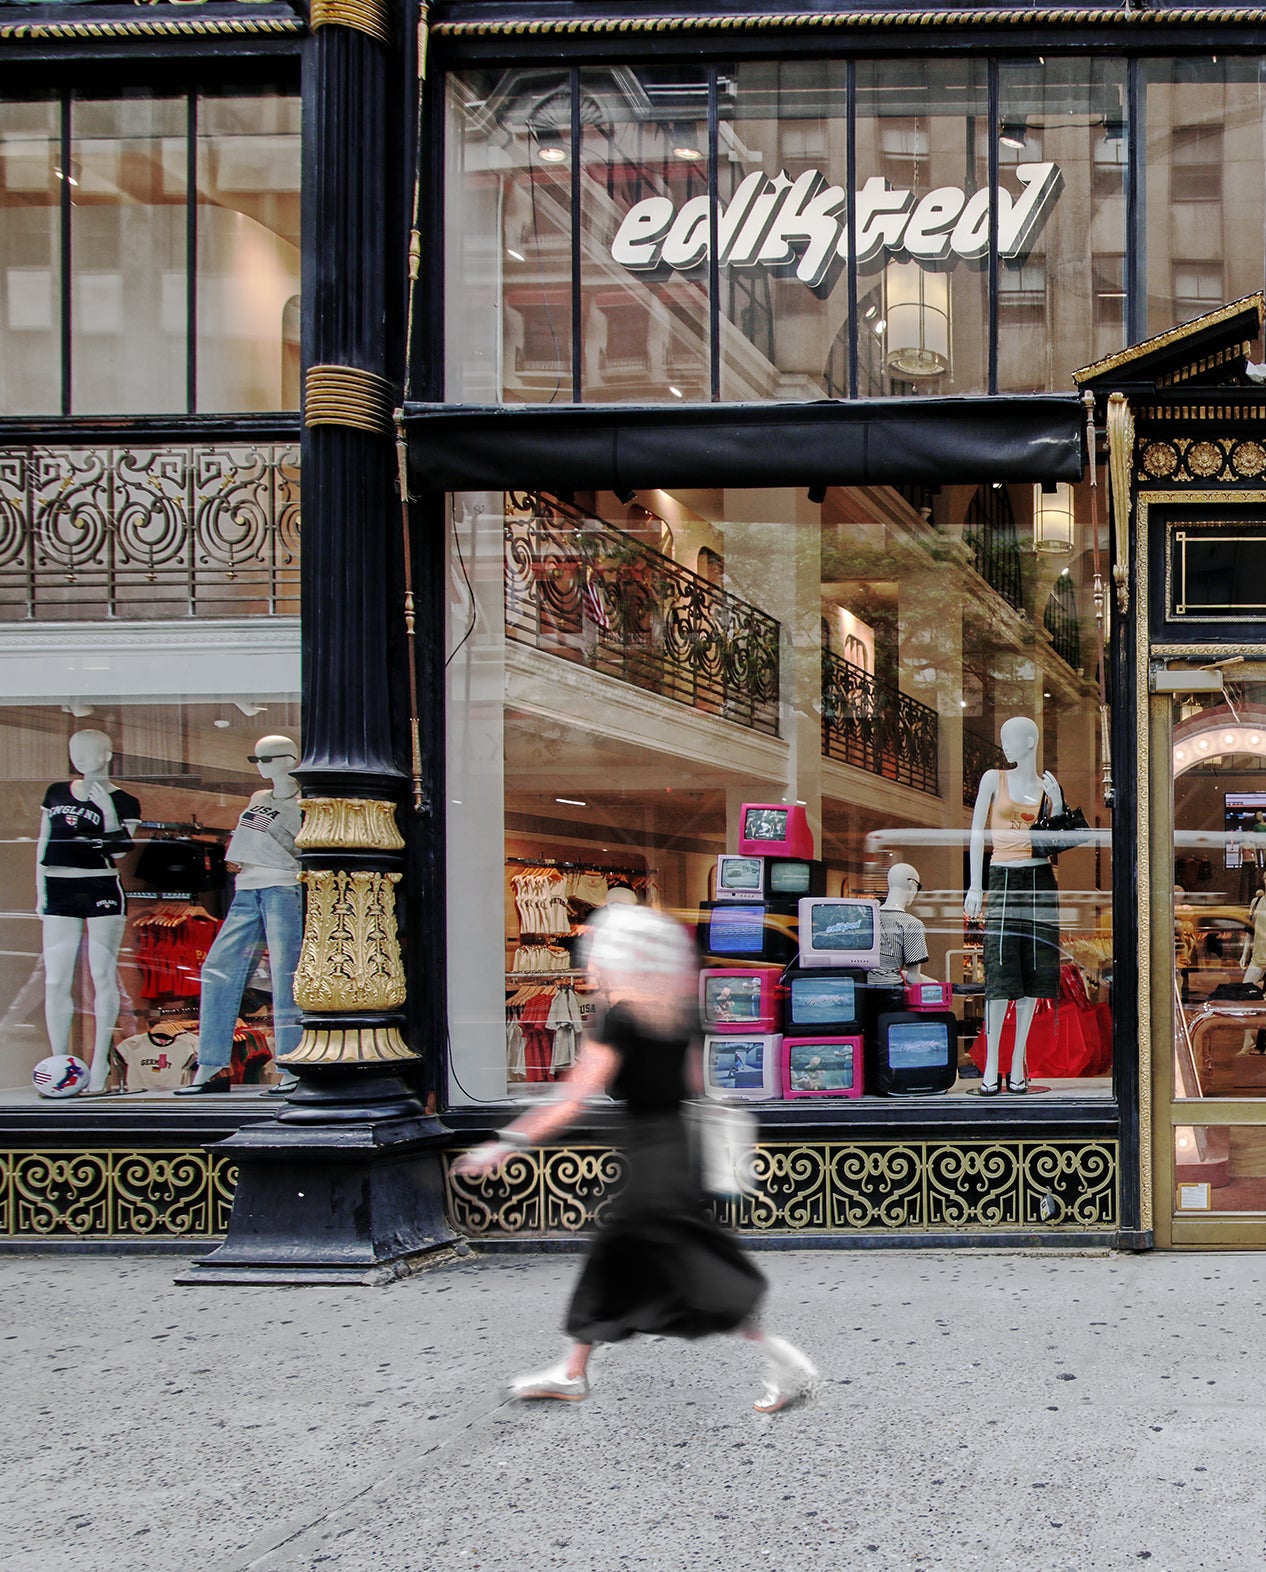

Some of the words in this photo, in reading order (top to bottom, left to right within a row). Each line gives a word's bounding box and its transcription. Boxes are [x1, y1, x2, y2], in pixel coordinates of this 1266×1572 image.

[611, 162, 1063, 290] edikted
[48, 805, 101, 826] ENGLAND
[249, 805, 281, 820] USA
[580, 1003, 597, 1014] USA
[140, 1057, 172, 1070] GERMY
